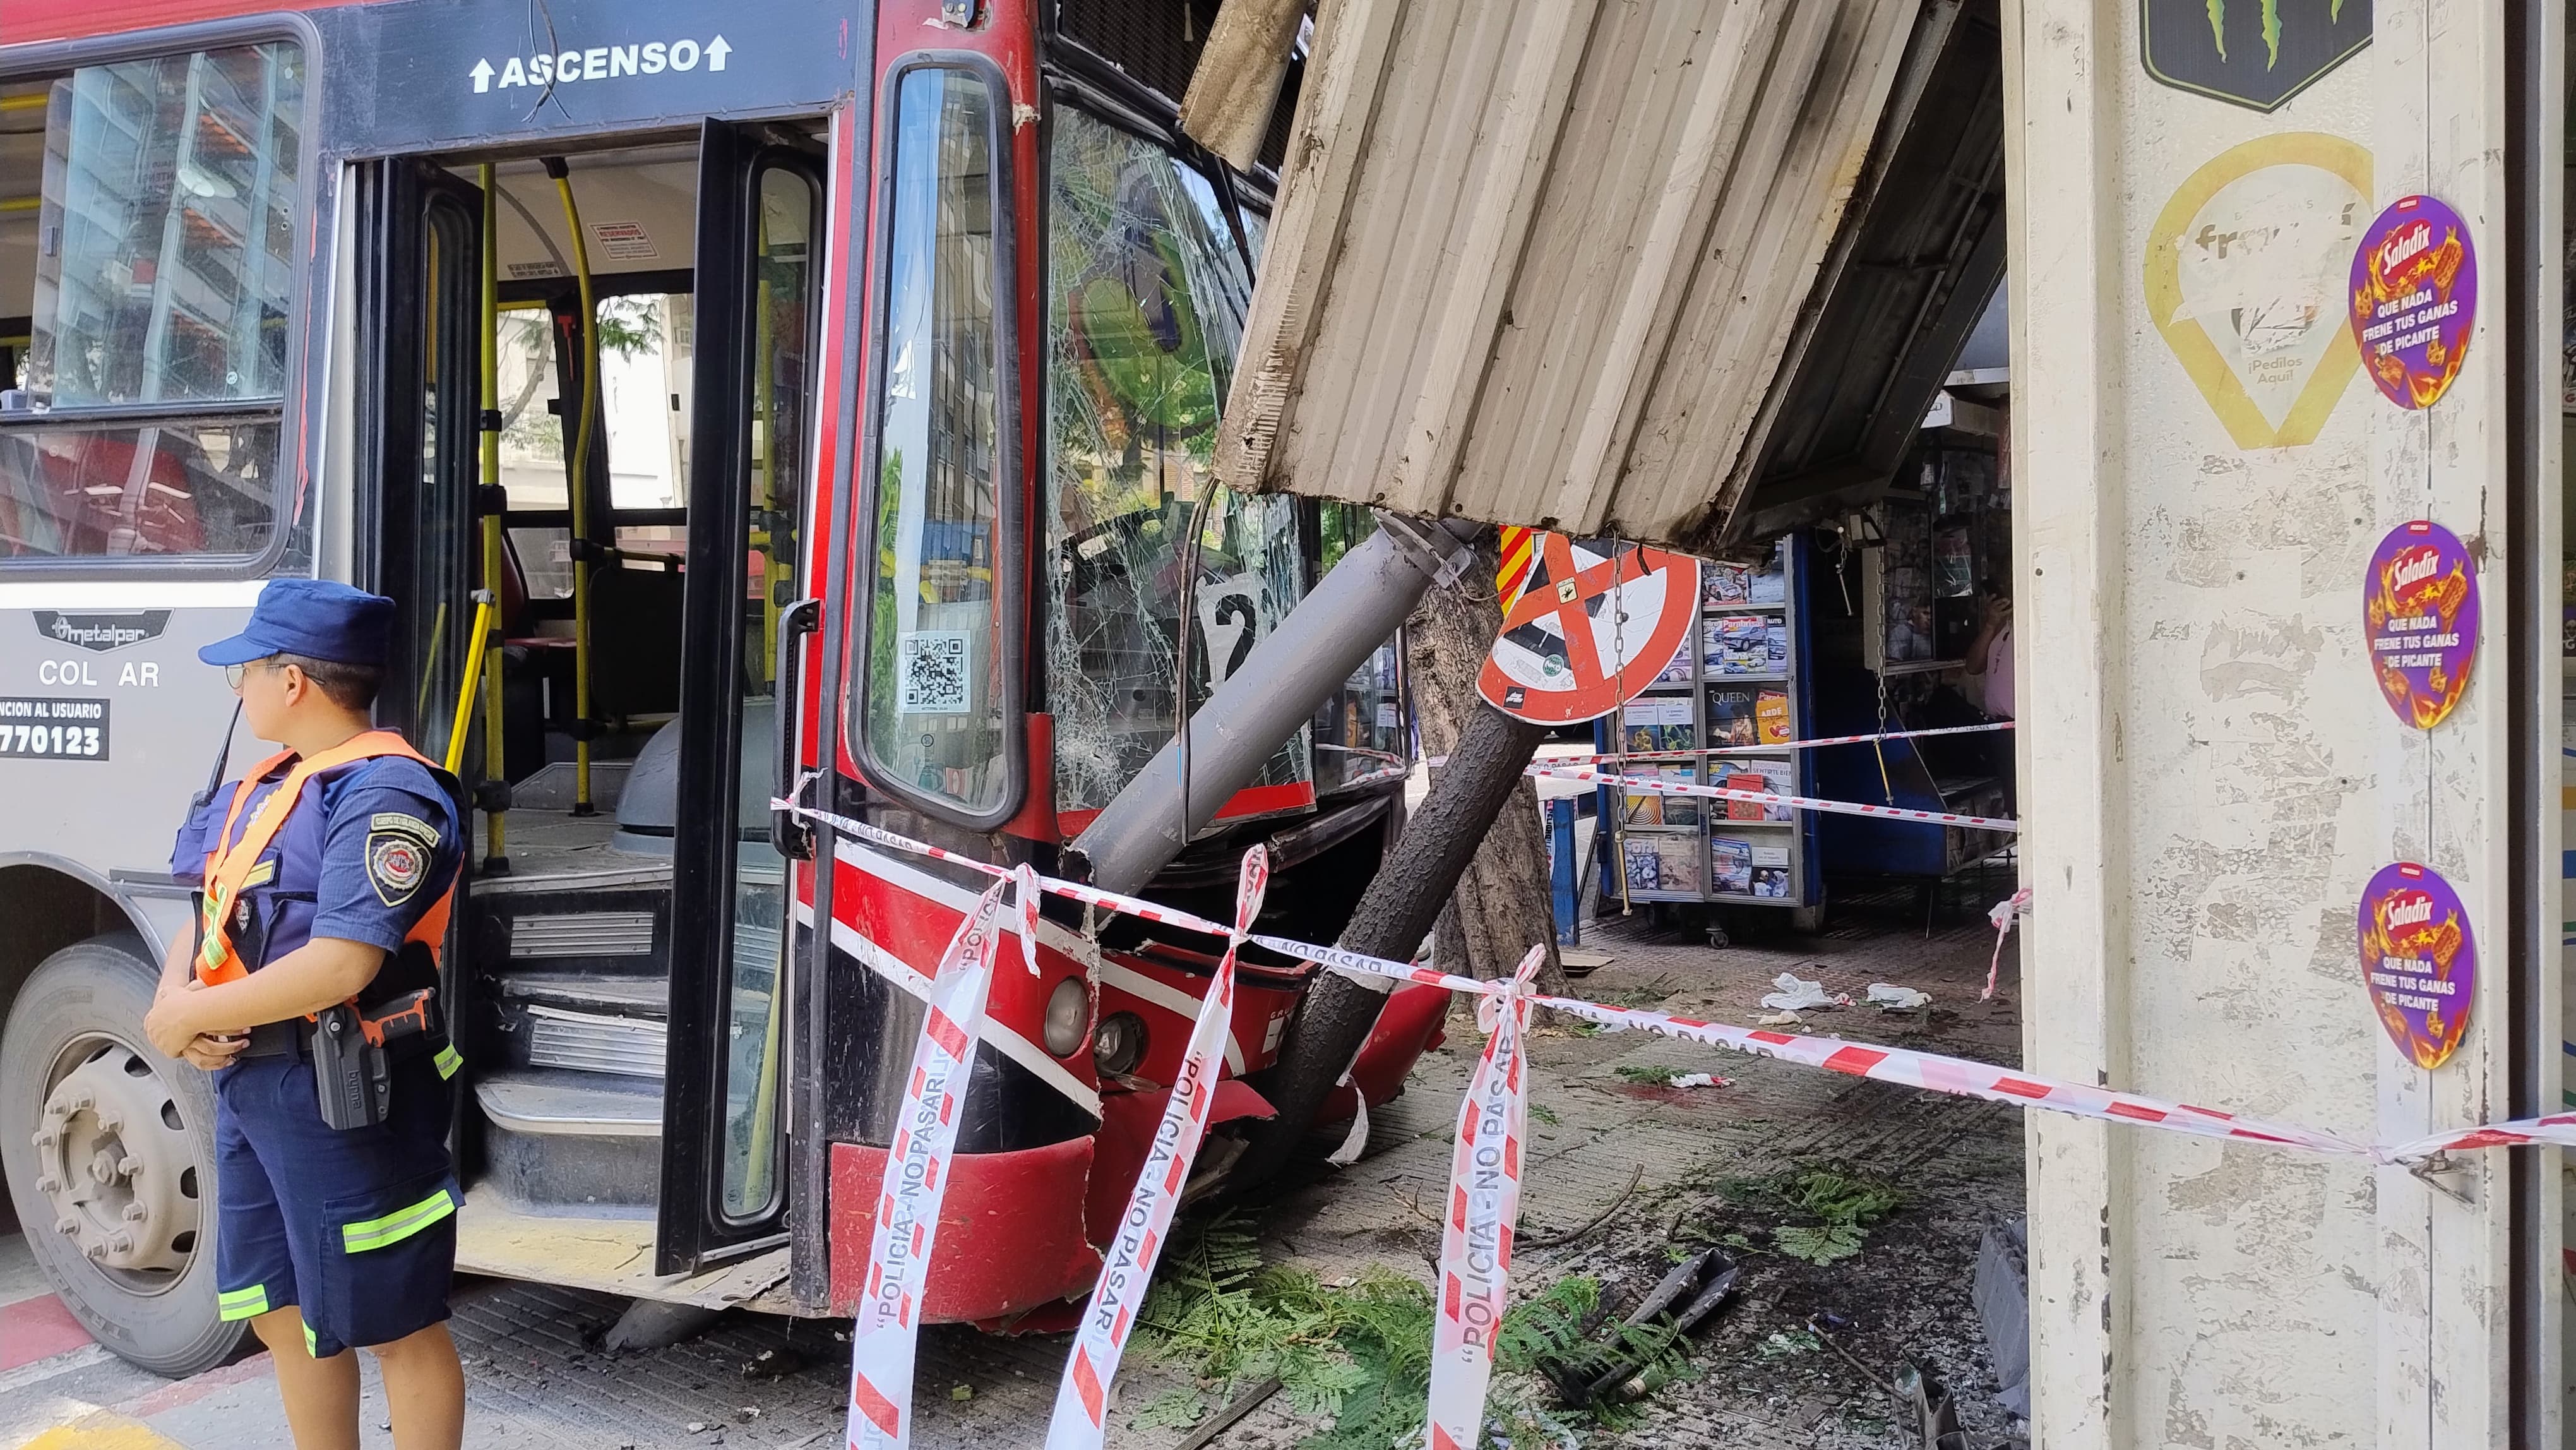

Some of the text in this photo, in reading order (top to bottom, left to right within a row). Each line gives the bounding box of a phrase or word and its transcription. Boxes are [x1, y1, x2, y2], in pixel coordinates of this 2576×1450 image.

[498, 39, 701, 89] ASCENSO
[2383, 223, 2431, 276] Saladix
[2377, 289, 2432, 318] QUE NADA
[2363, 300, 2458, 342] FRENE TUS GANAS
[2380, 326, 2440, 356] DE PICANTE
[2394, 550, 2439, 592] Saladix
[63, 623, 146, 647] metalpar
[2388, 616, 2437, 632] QUE NADA
[2374, 633, 2459, 650] FRENE TUS GANAS
[39, 660, 159, 687] COL AR
[2387, 653, 2443, 668] DE PICANTE
[34, 702, 49, 718] AL
[52, 702, 102, 720] USUARIO
[1712, 692, 1750, 705] QUEEN
[1762, 707, 1783, 717] ARDE
[0, 724, 100, 756] 770123
[2387, 896, 2433, 931] Saladix
[2383, 957, 2433, 974] QUE NADA
[2370, 972, 2455, 995] FRENE TUS GANAS
[2385, 992, 2439, 1012] DE PICANTE
[910, 1077, 946, 1156] PASAR
[900, 1162, 924, 1197] NO
[1474, 1146, 1501, 1190] NO
[1129, 1187, 1157, 1227] NO
[1094, 1234, 1138, 1333] PASAR
